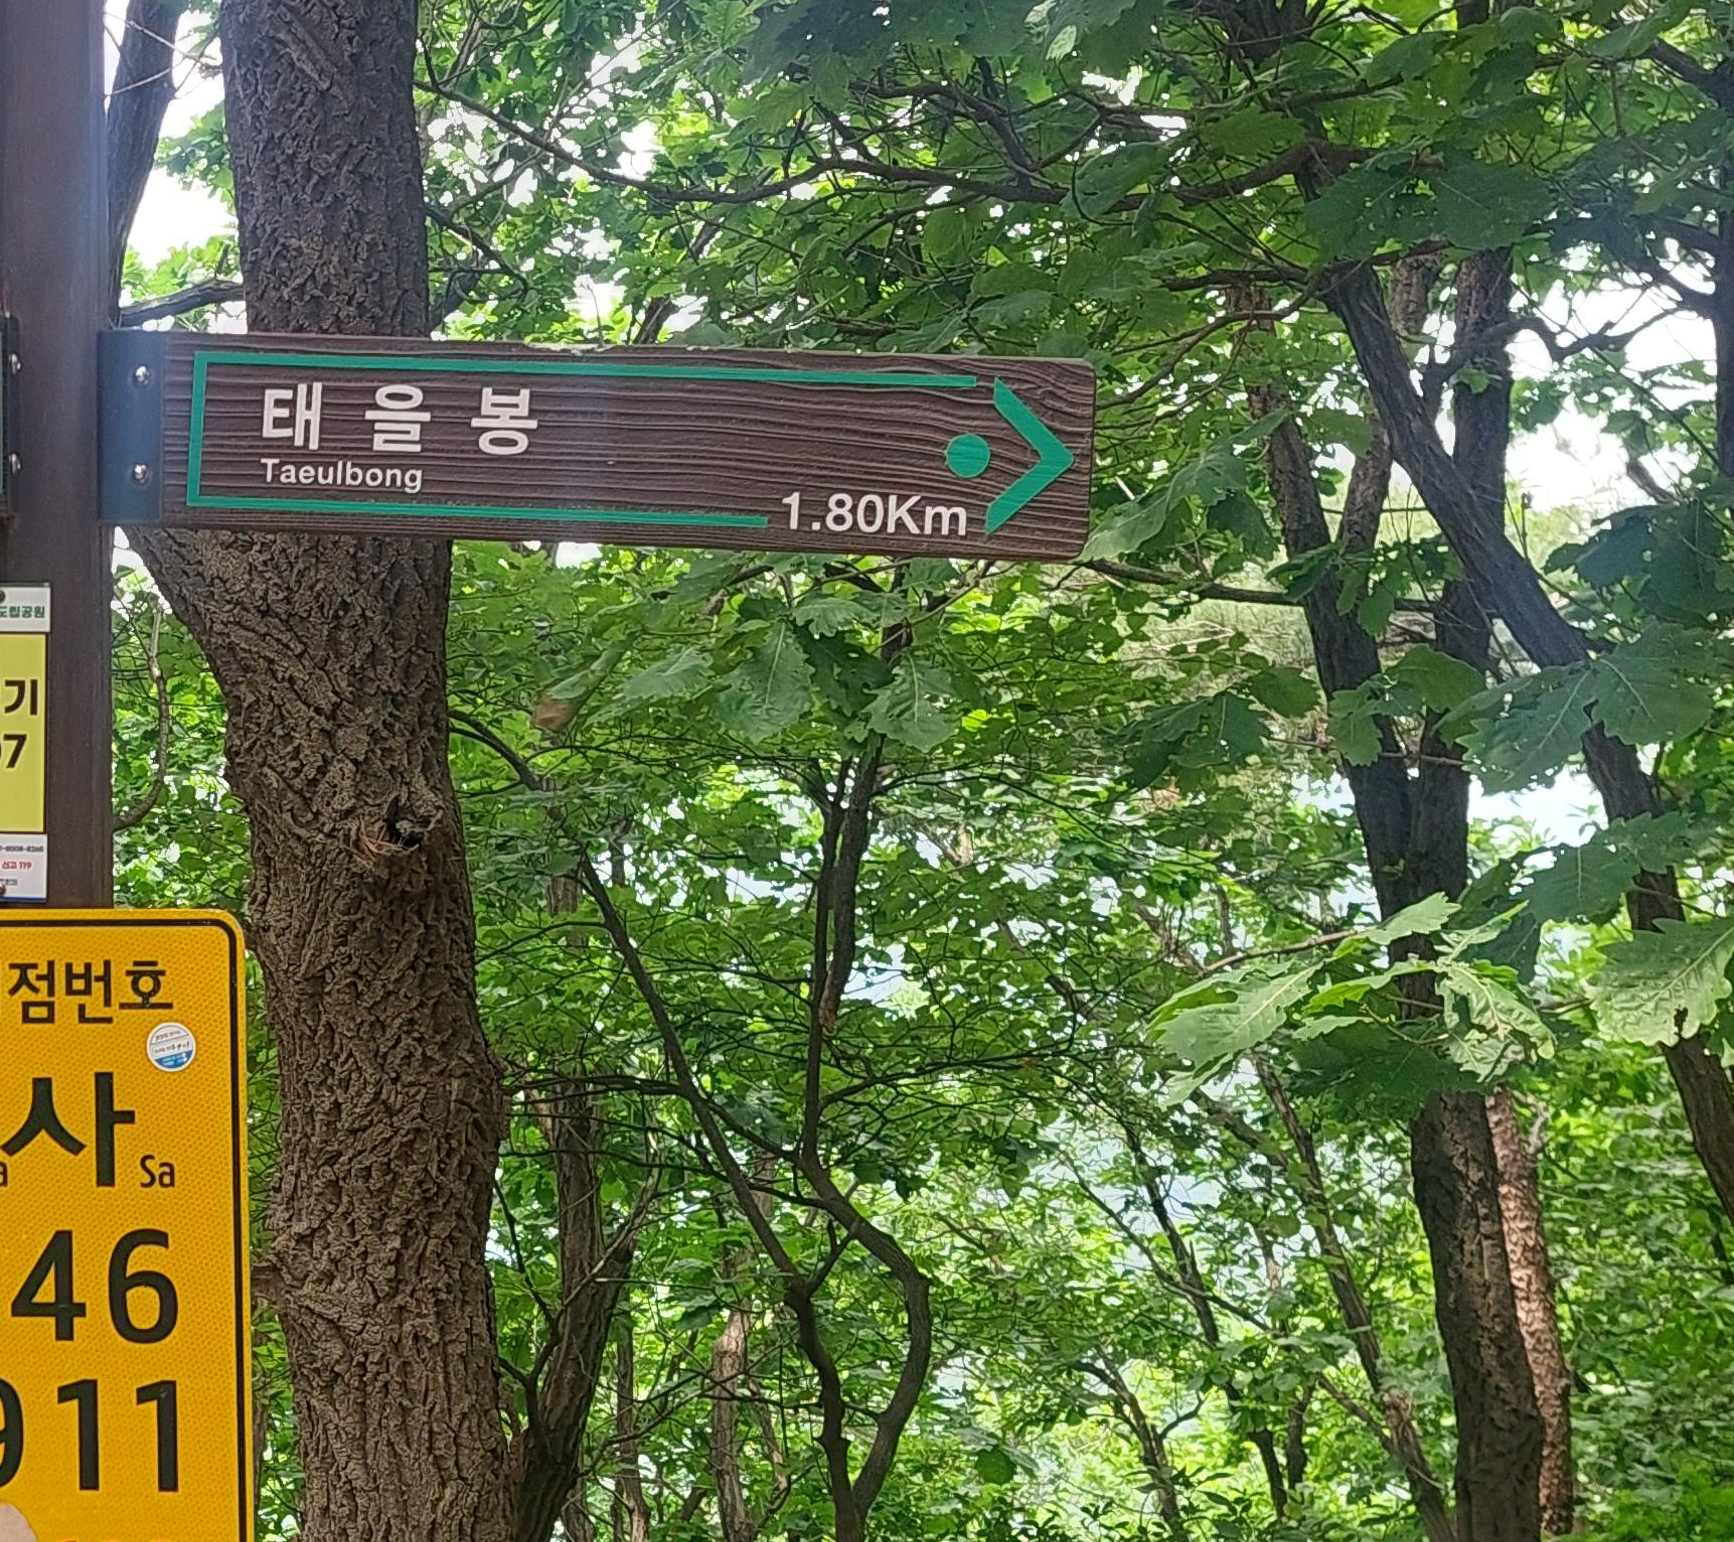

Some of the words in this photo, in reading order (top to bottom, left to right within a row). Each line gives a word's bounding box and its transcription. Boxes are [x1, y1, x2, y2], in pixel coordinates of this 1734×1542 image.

[260, 458, 423, 493] Taeulbong
[781, 493, 969, 537] 1.80Km
[19, 861, 32, 870] 119
[140, 1156, 176, 1188] Sa
